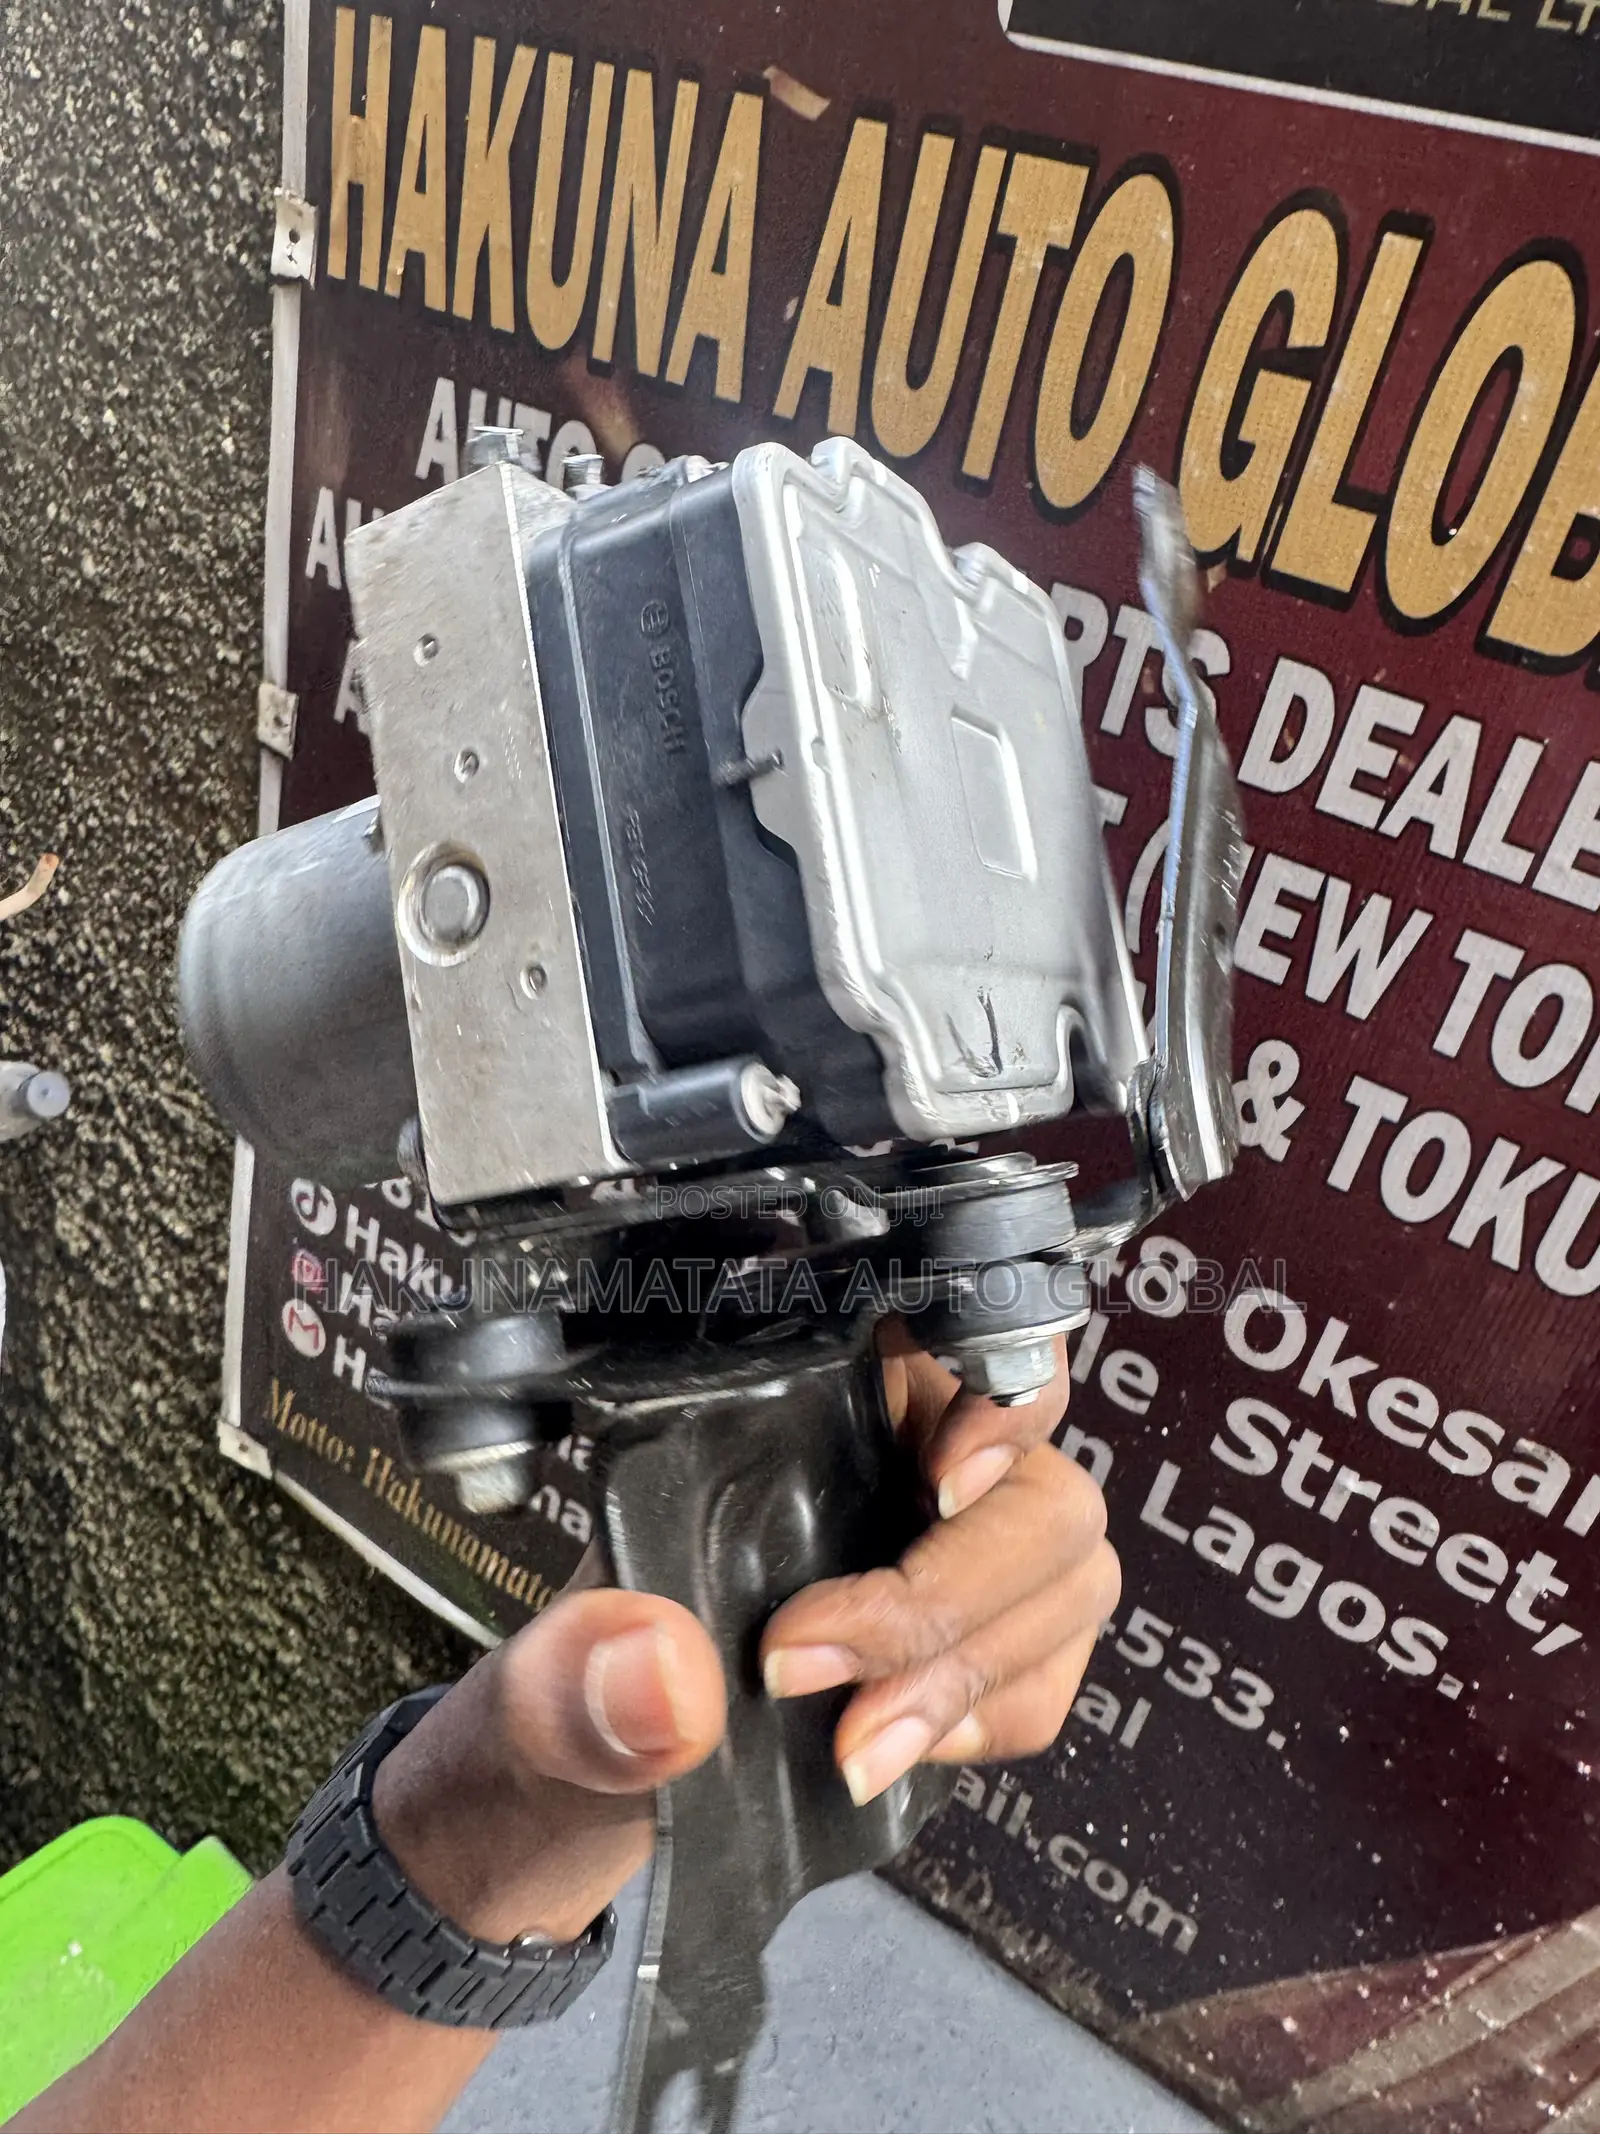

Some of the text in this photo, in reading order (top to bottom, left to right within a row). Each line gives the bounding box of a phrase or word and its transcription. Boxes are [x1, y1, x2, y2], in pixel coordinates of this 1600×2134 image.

[327, 7, 764, 404] HAKUNA
[772, 117, 1174, 509] AUTO
[1232, 1040, 1304, 1162] &
[263, 1378, 355, 1473] Motto:
[1138, 1459, 1464, 1701] Lagos.
[1210, 1397, 1583, 1656] Street,
[1101, 1606, 1287, 1750] 533.
